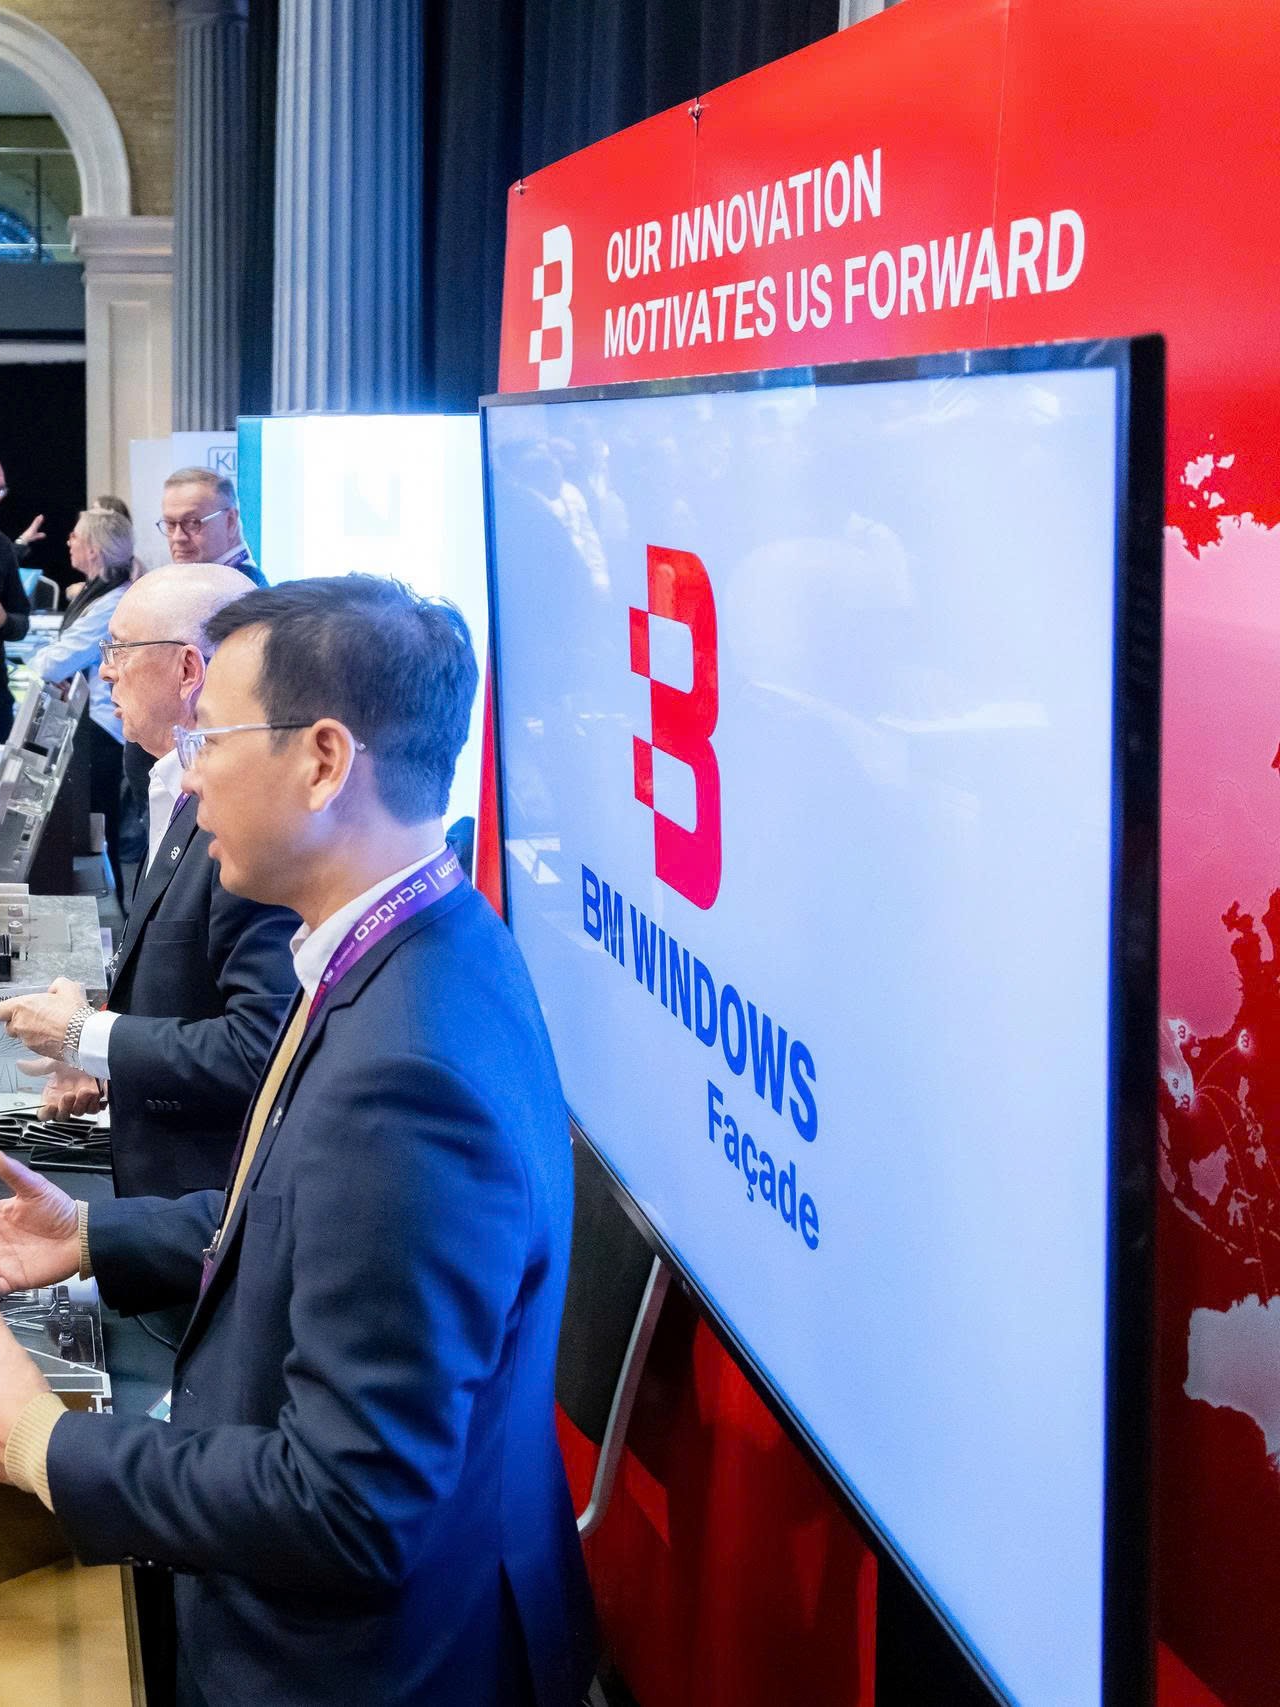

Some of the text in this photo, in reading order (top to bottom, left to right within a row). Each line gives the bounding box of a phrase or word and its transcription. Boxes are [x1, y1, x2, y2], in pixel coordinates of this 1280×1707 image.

[604, 208, 1087, 359] MOTIVATES US FORWARD
[606, 147, 883, 283] OUR INNOVATION
[354, 879, 428, 942] SCHÜCO
[581, 863, 819, 1144] BM WINDOWS
[707, 1079, 820, 1251] Façade
